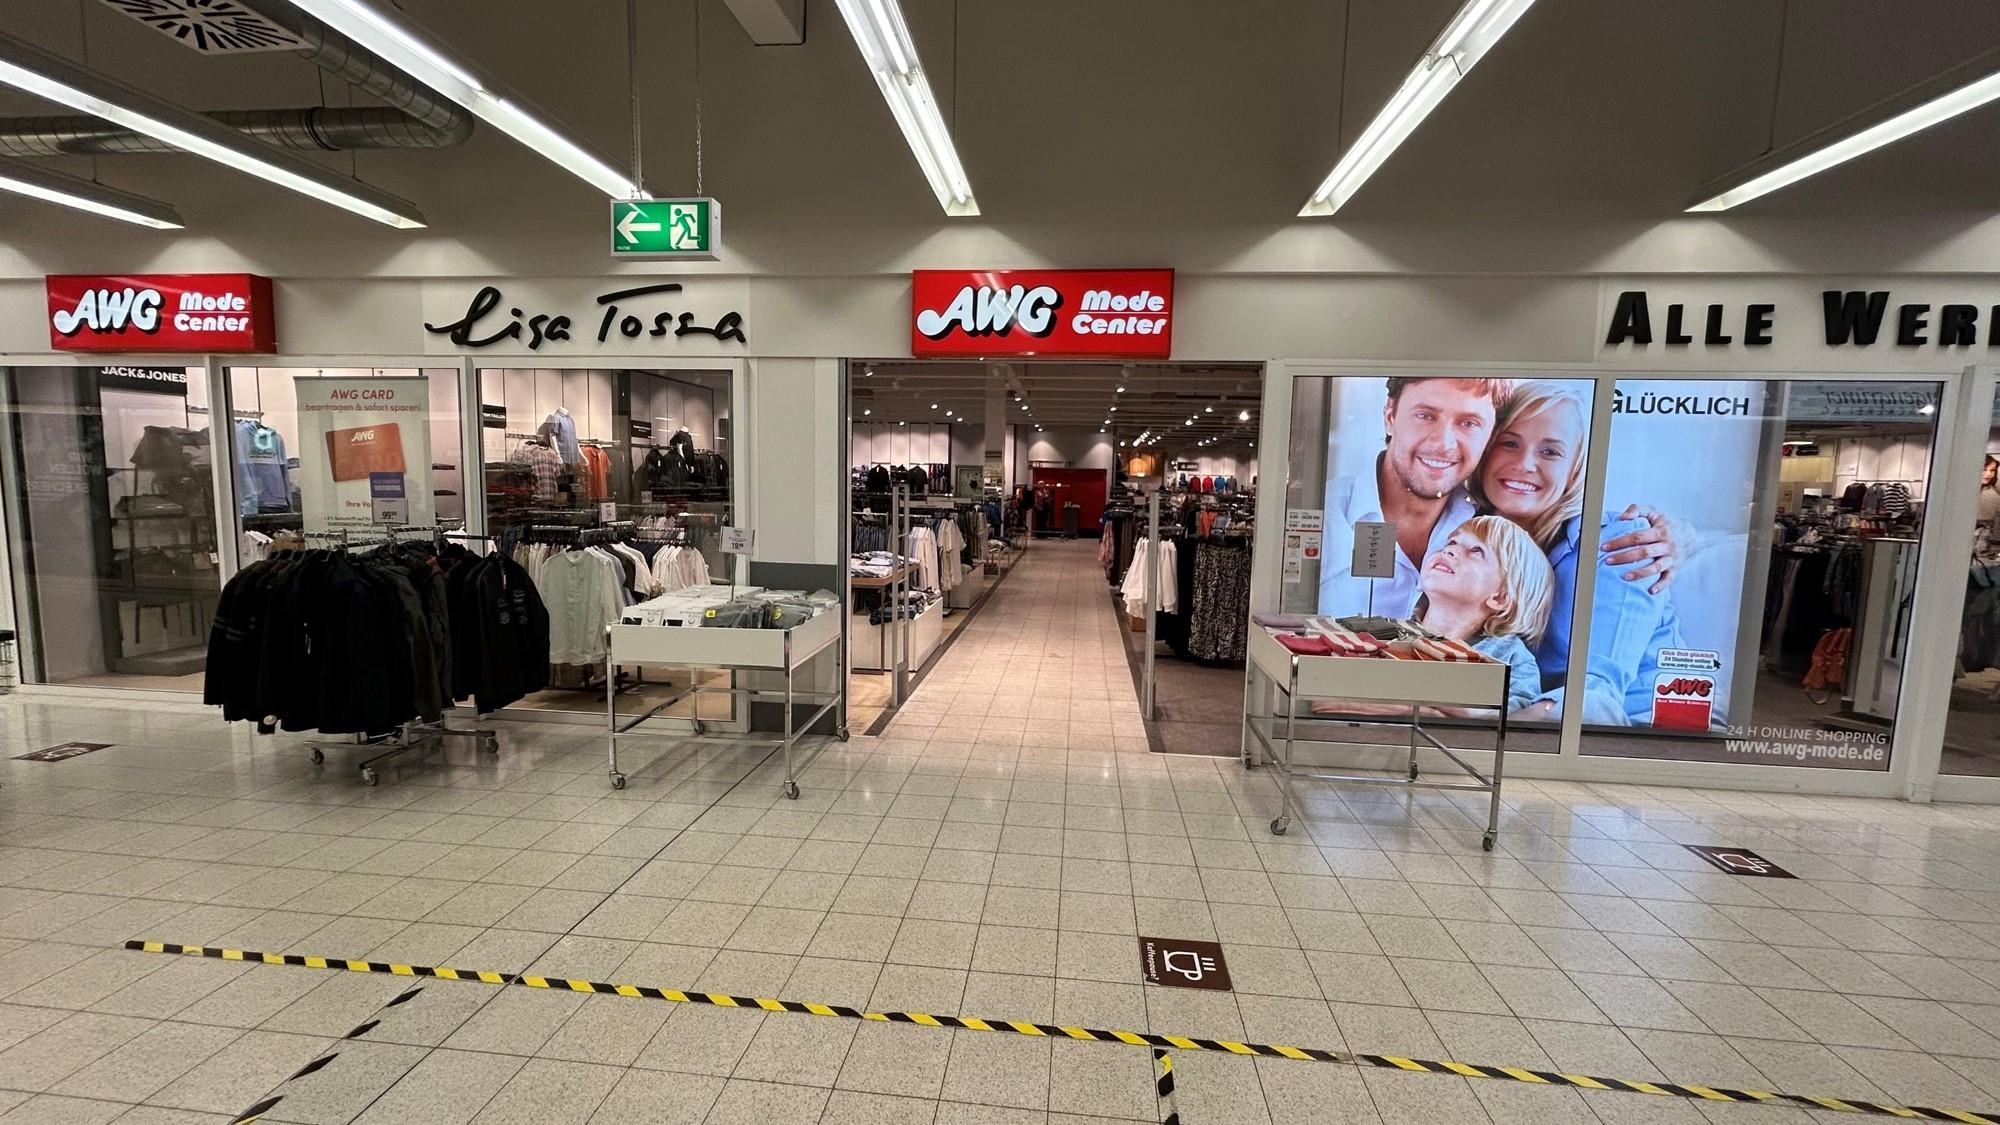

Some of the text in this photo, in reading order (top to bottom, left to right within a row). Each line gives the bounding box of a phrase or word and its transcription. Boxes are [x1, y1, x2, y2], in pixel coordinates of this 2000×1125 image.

[179, 292, 246, 311] Mode
[1080, 290, 1165, 311] Mode
[54, 288, 163, 335] AWG
[424, 283, 746, 349] Lisa Tossa
[917, 285, 1061, 337] AWG
[1606, 291, 1775, 345] ALLE
[174, 313, 249, 331] Center
[1072, 313, 1167, 334] Center
[101, 366, 187, 383] JACK&JONES
[331, 389, 395, 400] AWG CARD
[351, 430, 375, 442] AWG
[1657, 677, 1713, 697] AWG
[1726, 725, 1887, 745] 24 H ONLINE SHOPPING
[1725, 739, 1884, 761] www.awg-mode.de
